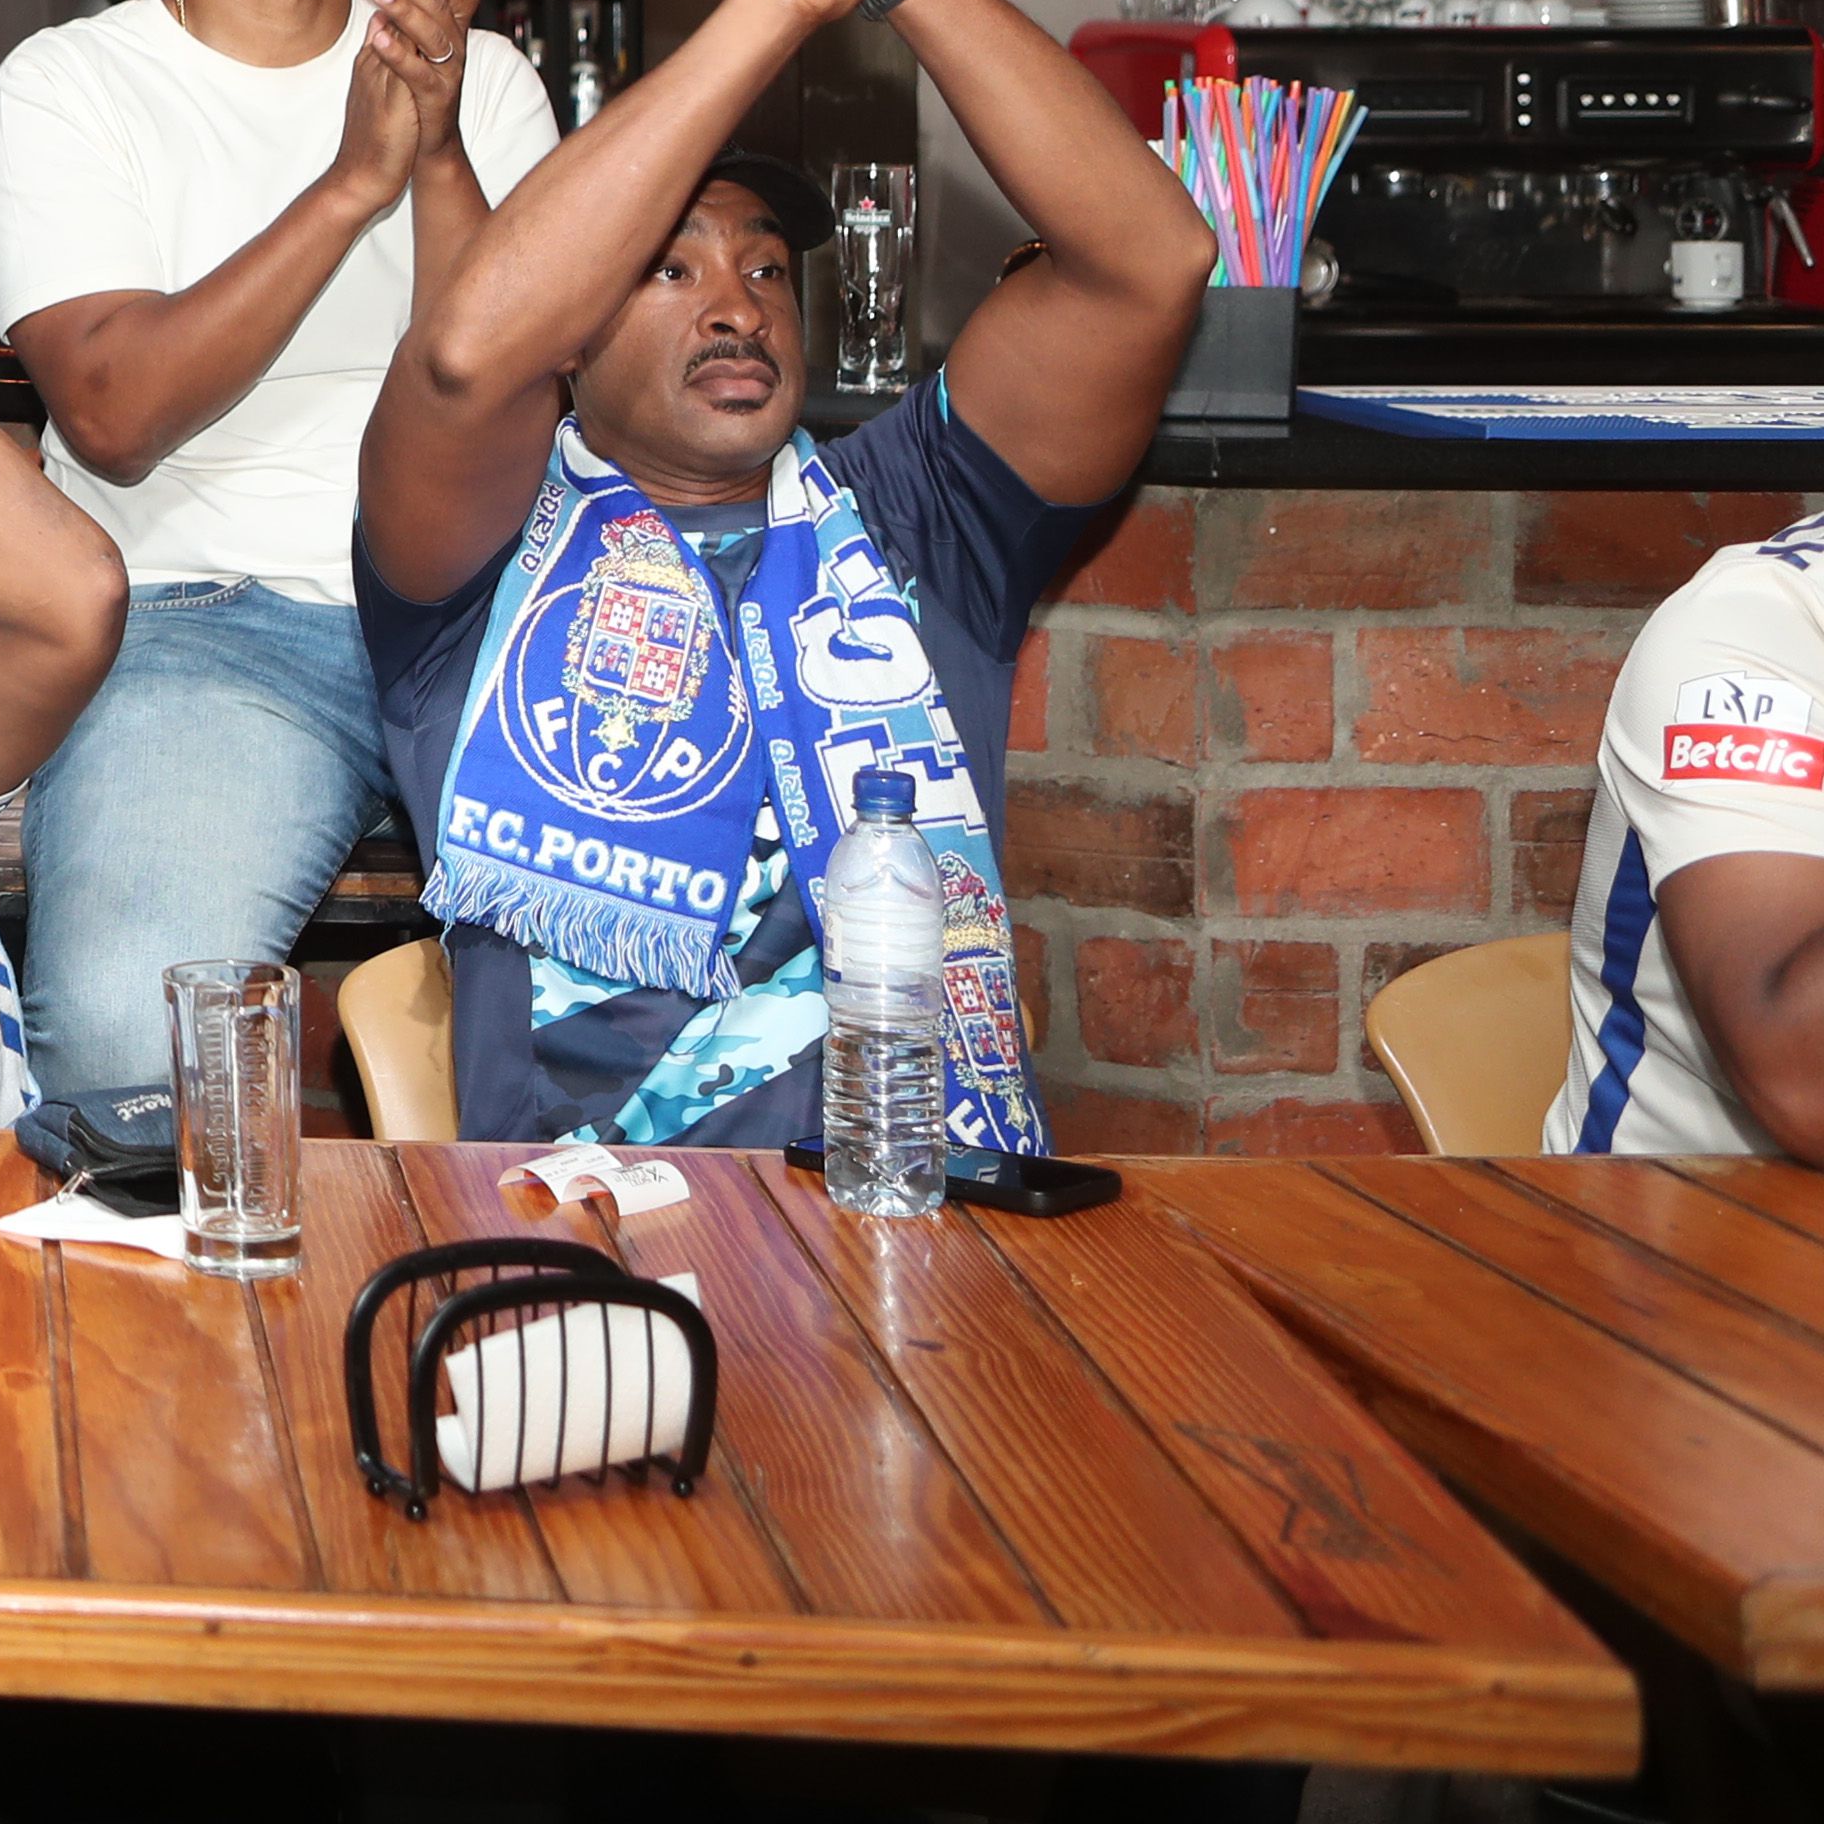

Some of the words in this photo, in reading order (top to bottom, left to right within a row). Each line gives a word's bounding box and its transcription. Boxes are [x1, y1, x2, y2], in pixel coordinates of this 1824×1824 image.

[738, 600, 785, 712] PORTO
[768, 736, 820, 849] PORTO
[1669, 733, 1814, 778] Betclic
